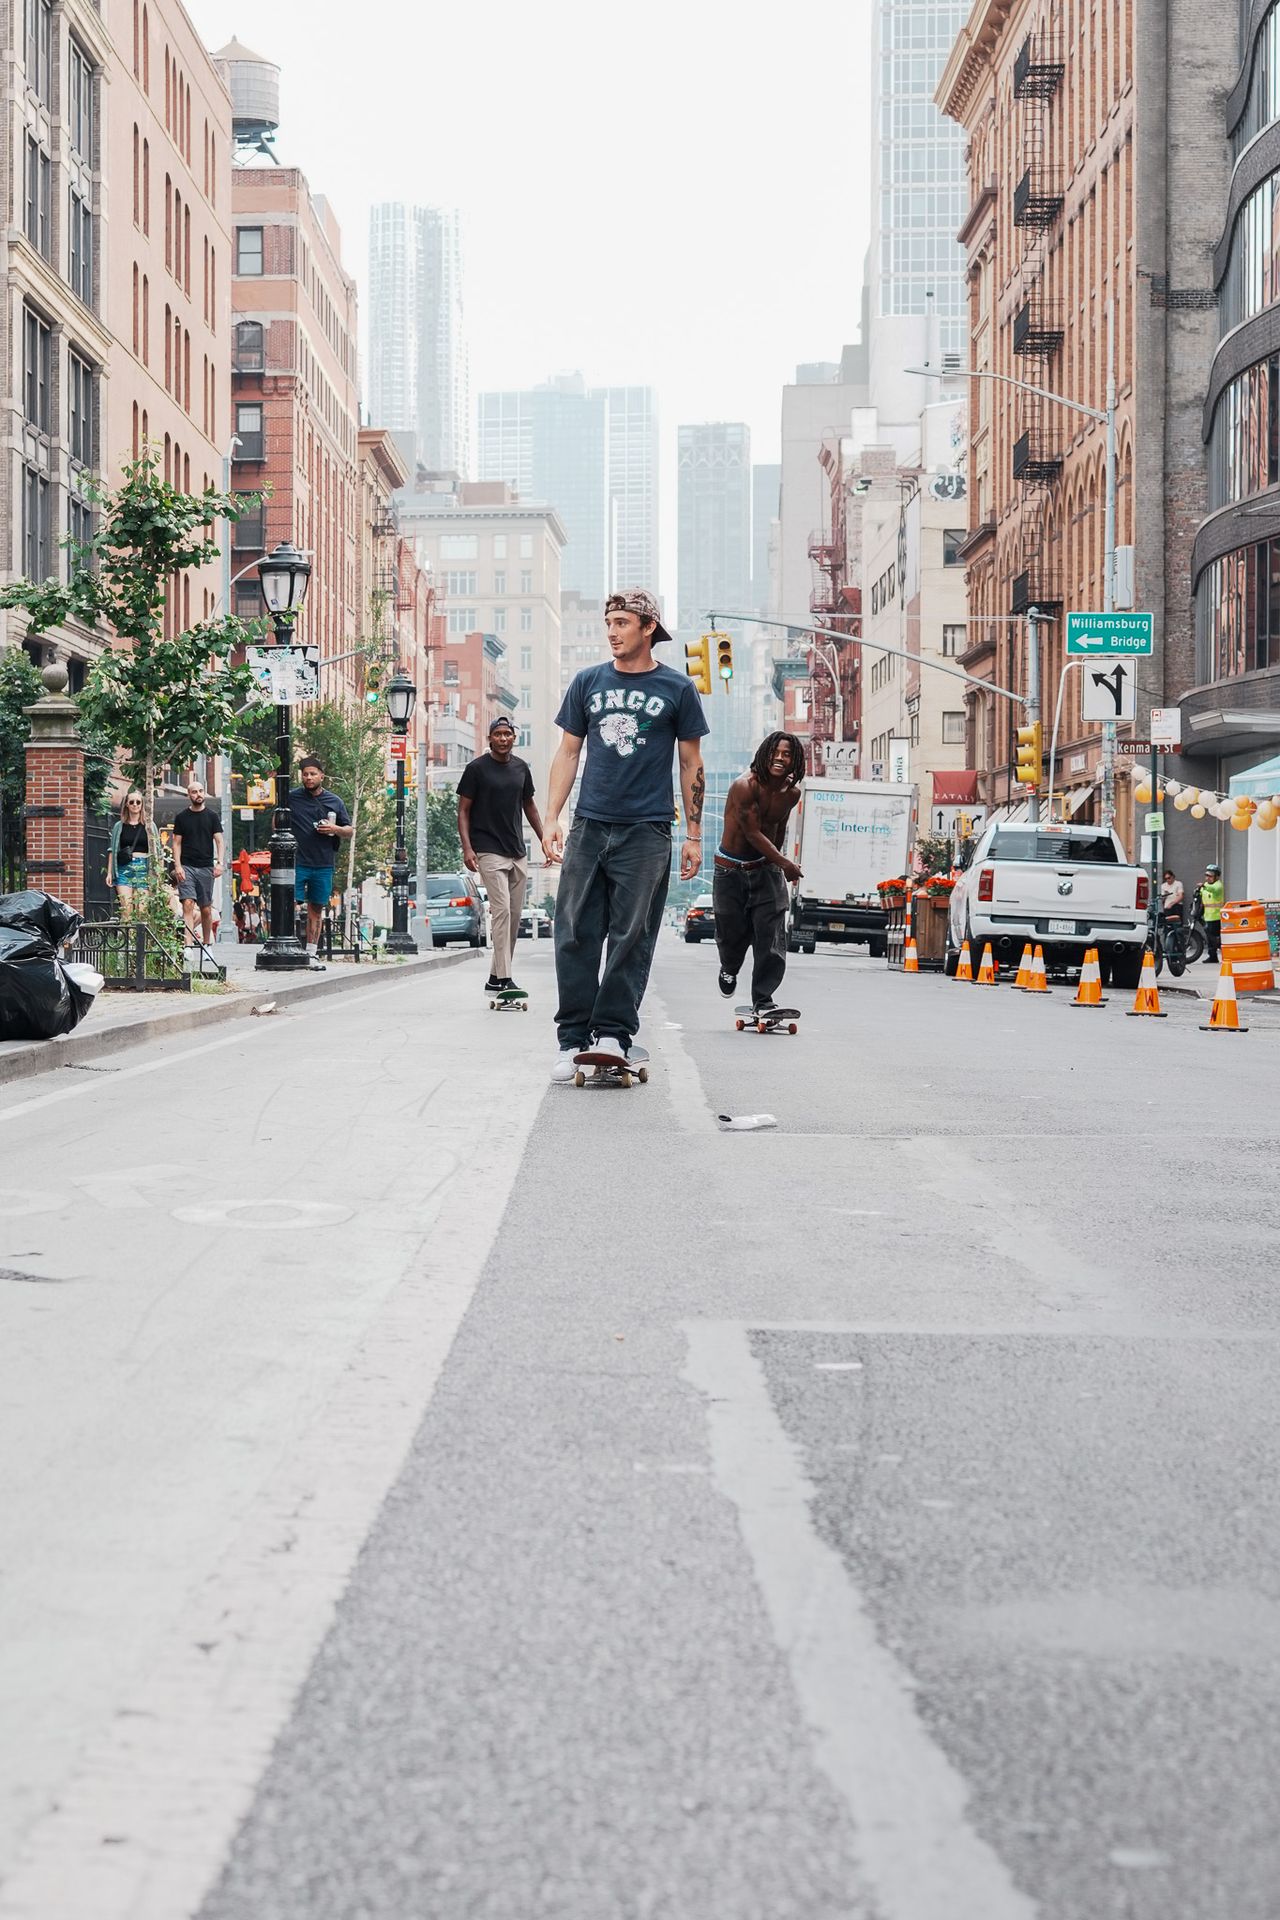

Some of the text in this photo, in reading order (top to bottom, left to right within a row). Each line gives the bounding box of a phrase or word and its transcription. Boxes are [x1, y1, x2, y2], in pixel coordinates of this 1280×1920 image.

[1071, 618, 1149, 632] Williamsburg
[1110, 636, 1147, 649] Bridge
[1118, 743, 1174, 753] Kenmae St
[934, 793, 975, 803] EATALY
